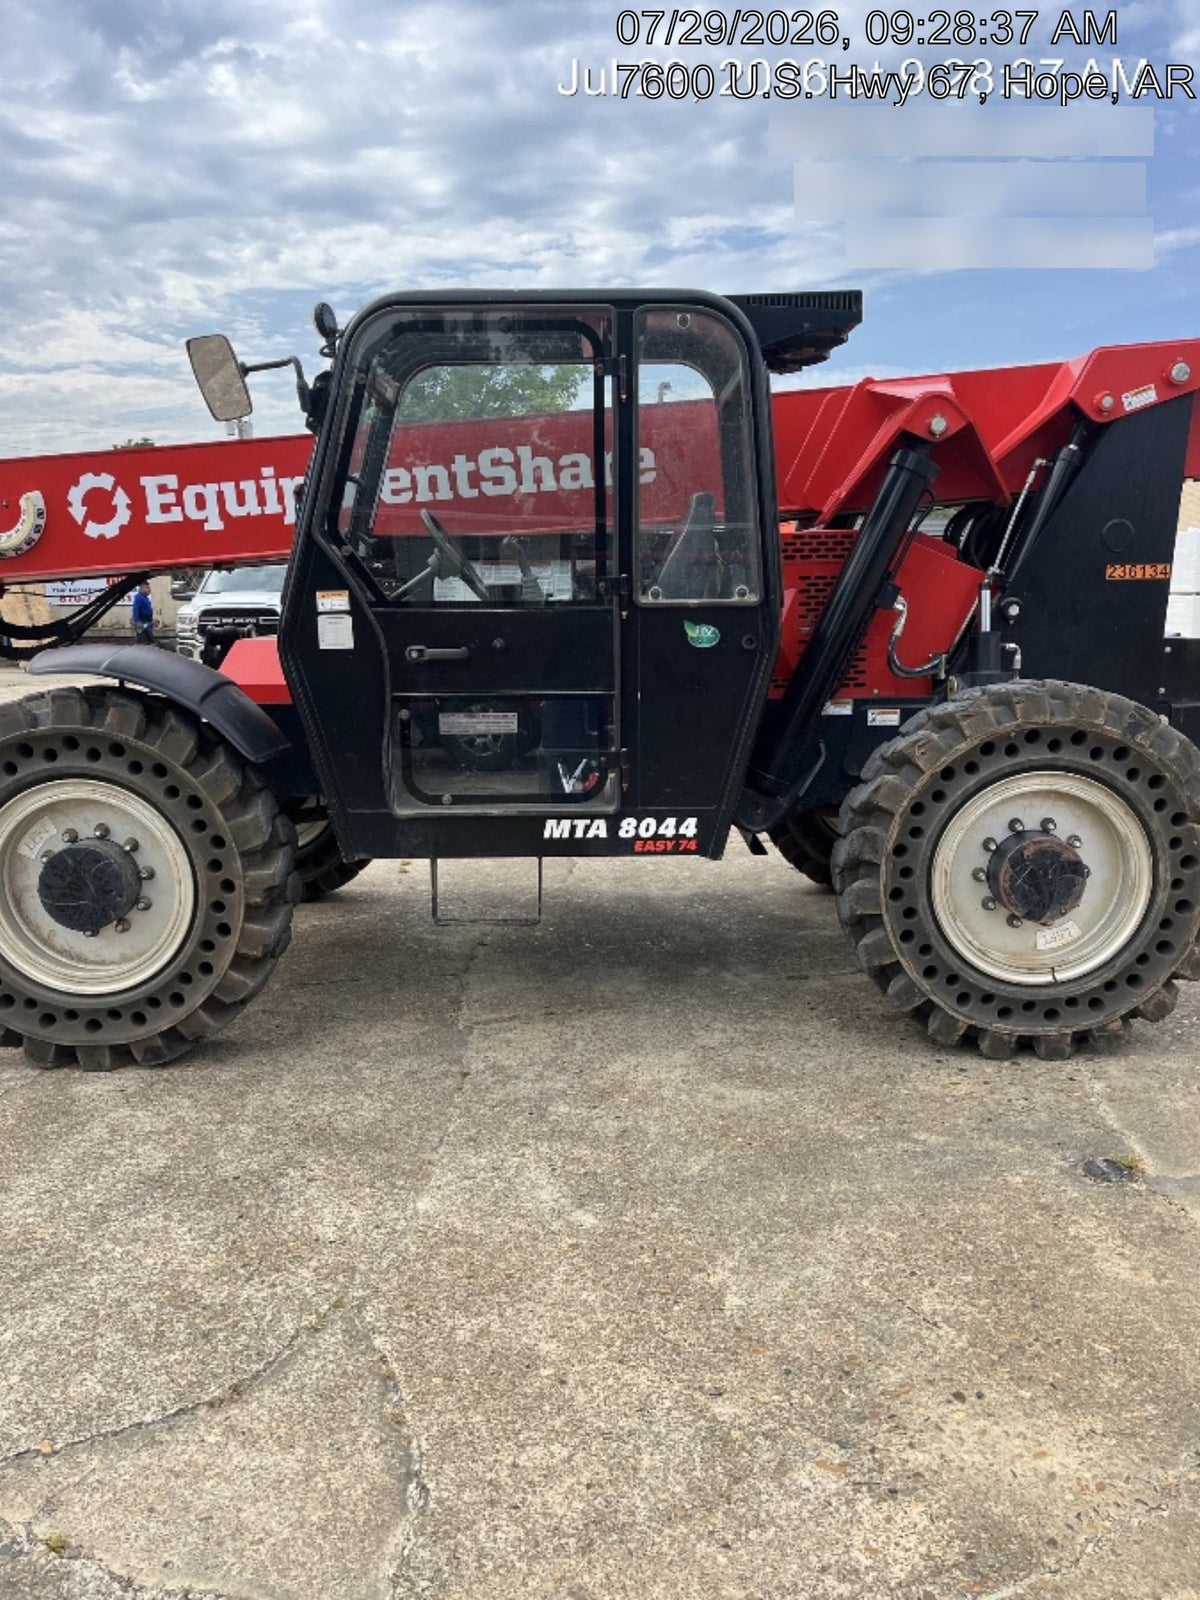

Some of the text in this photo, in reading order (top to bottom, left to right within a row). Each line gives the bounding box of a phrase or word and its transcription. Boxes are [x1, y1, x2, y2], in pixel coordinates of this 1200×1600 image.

[140, 446, 657, 531] EquipentShare
[1107, 564, 1169, 579] 236134
[543, 817, 698, 839] MTA 8044
[633, 839, 698, 853] EASY 74
